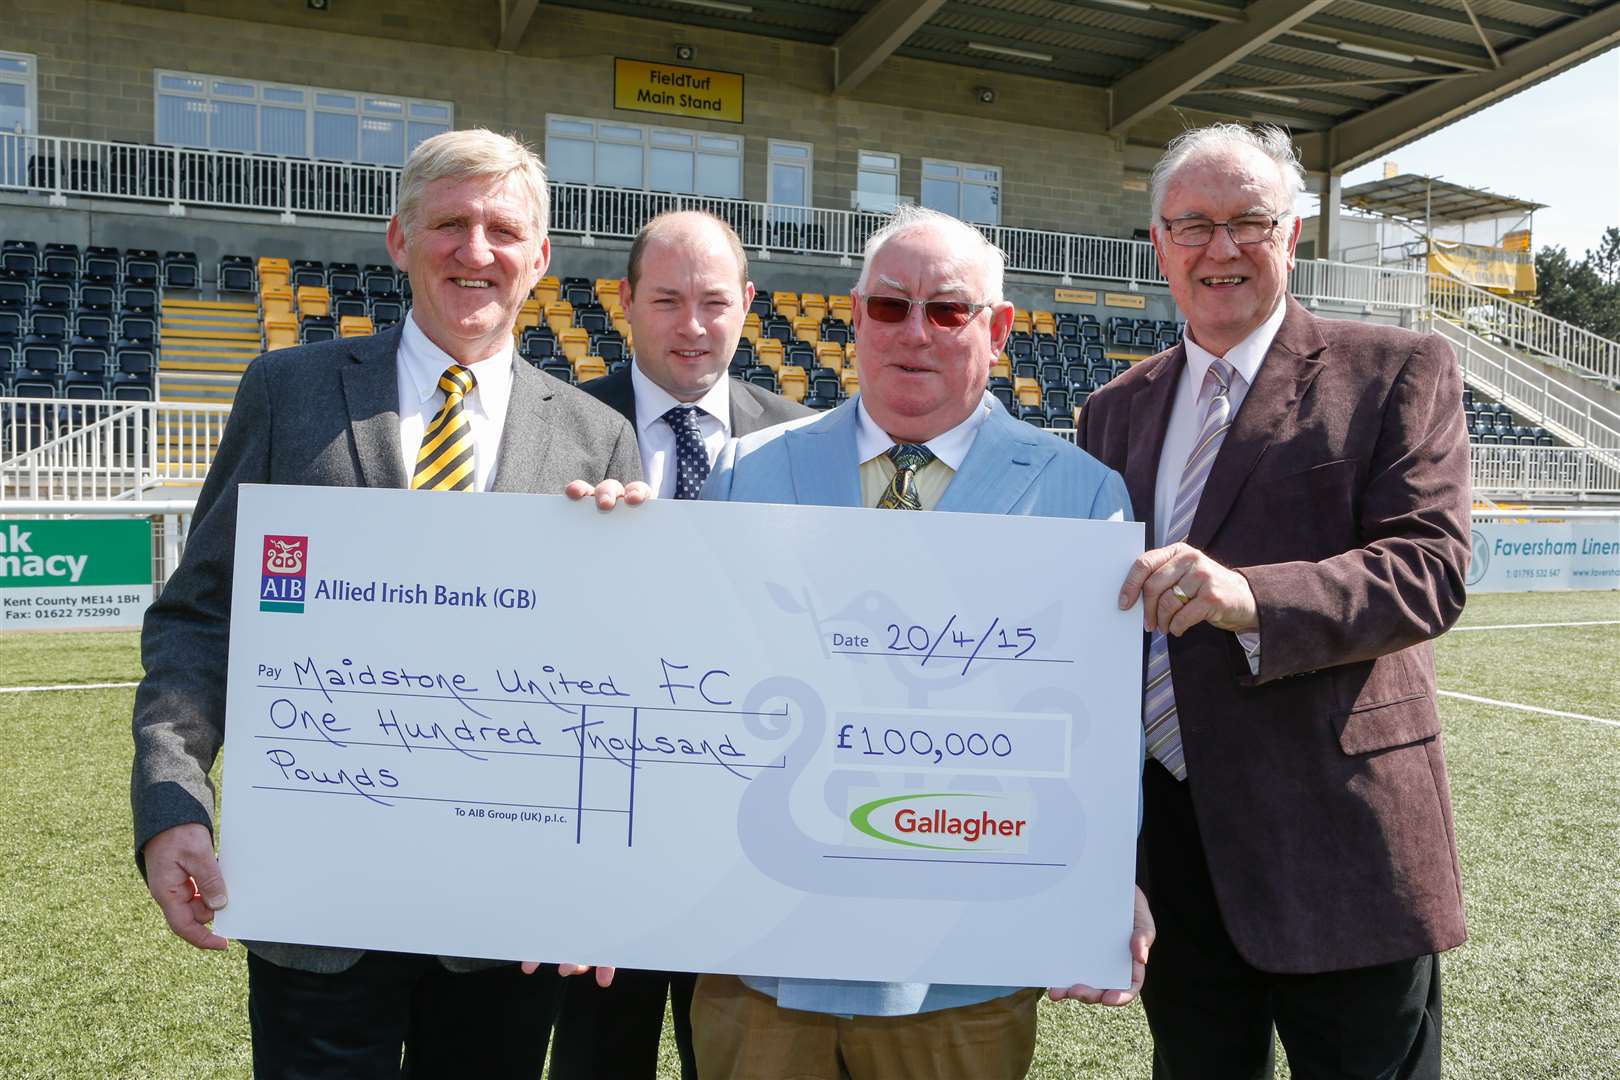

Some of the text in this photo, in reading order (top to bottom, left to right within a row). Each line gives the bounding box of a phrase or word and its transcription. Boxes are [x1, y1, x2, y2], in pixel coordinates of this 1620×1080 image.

[650, 70, 711, 90] FieldTurf
[637, 89, 722, 111] Main Stand
[1494, 537, 1619, 556] Faversham Linen
[4, 594, 140, 608] Kent County ME14 1BH
[263, 578, 303, 599] AIB
[315, 579, 537, 610] Allied Irish Bank (GB)
[6, 607, 120, 619] Fax: 01622 752990
[832, 614, 1036, 676] Date 20/4/15
[258, 657, 732, 719] Pay Maidstone United FC
[270, 699, 752, 780] One Hundred Thousand
[837, 724, 1012, 764] £100,000
[267, 750, 398, 807] Pounds
[455, 807, 568, 823] To AIB Group (UK) p.l.c.
[894, 809, 1026, 842] Gallagher
